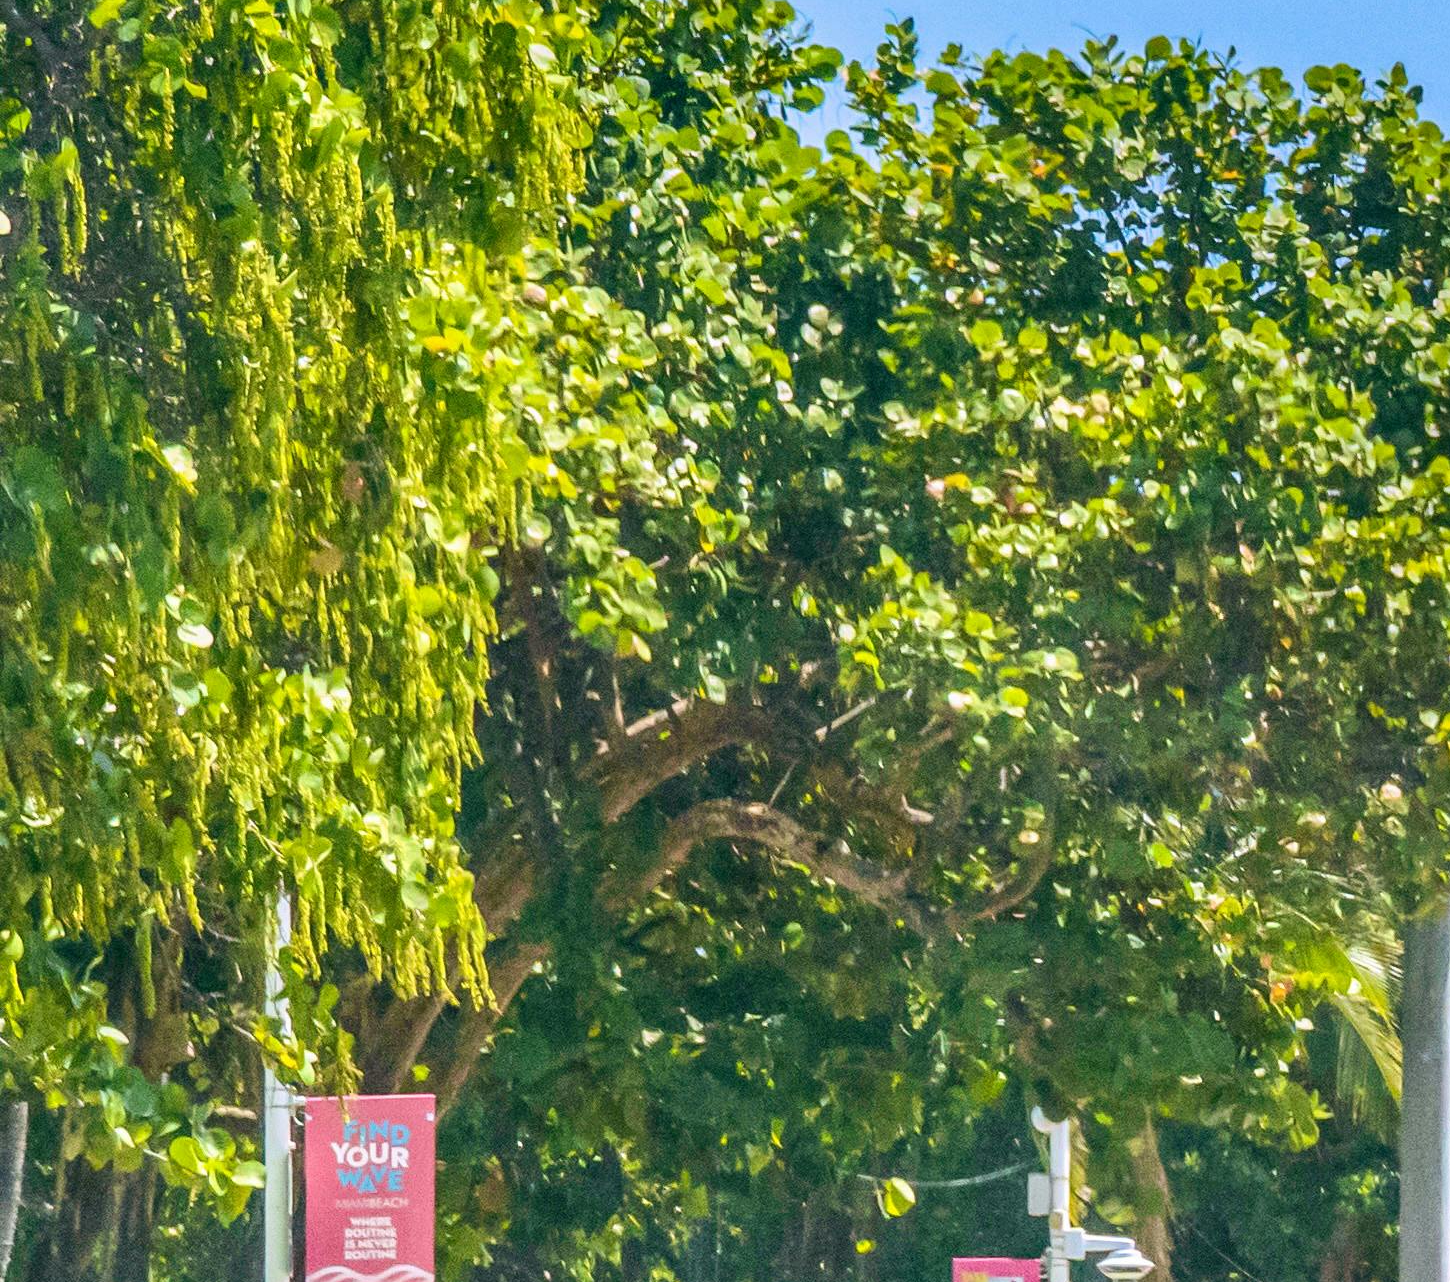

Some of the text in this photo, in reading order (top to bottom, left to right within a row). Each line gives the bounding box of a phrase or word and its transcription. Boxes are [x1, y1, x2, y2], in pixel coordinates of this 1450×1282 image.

[343, 1120, 411, 1146] FIND
[331, 1142, 410, 1169] YOUR
[336, 1165, 405, 1194] WAVE
